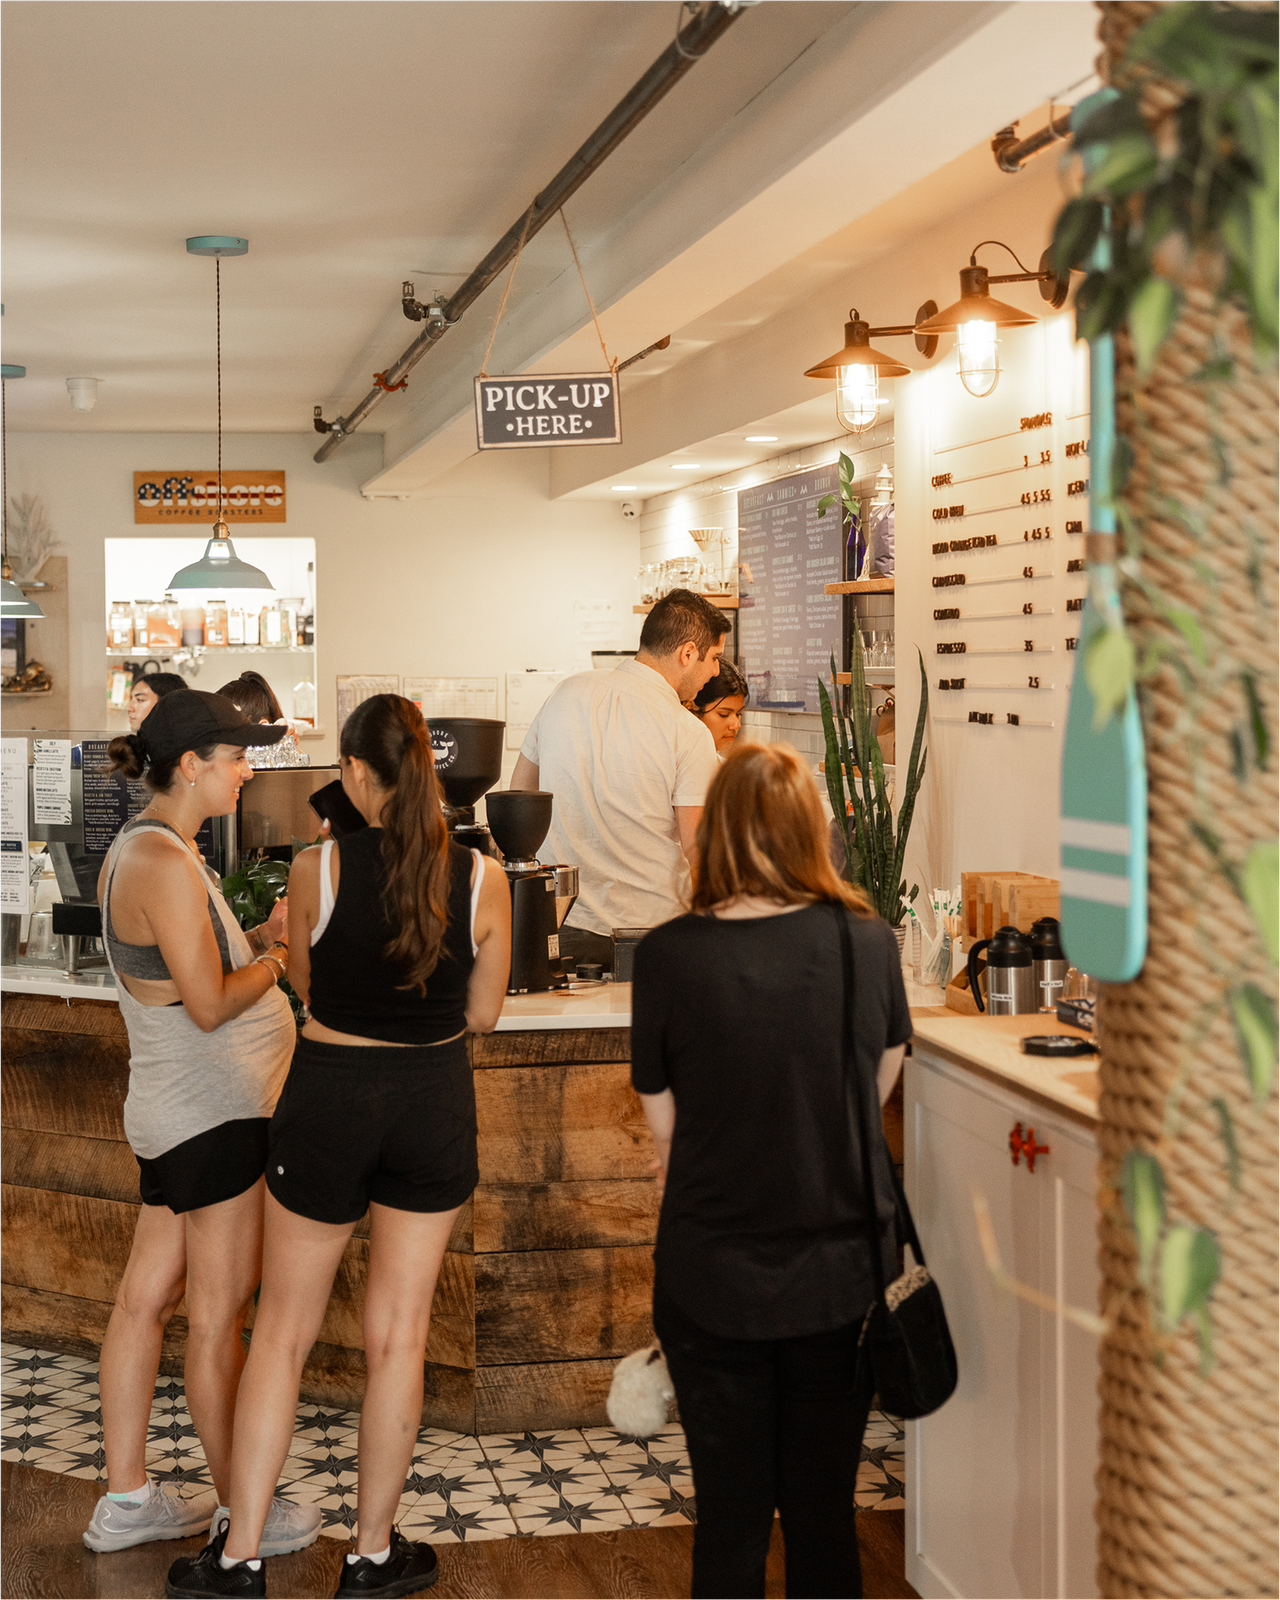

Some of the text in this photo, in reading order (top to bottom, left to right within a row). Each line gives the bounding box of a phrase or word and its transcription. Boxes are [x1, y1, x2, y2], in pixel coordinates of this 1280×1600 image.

[485, 383, 610, 411] PICK-UP
[515, 414, 583, 436] HERE
[814, 476, 831, 491] BRUNCH
[931, 472, 951, 488] COFFEE
[137, 476, 284, 507] offshore
[207, 508, 264, 516] ROASTERS
[932, 507, 949, 519] COLD
[985, 534, 998, 547] TEA
[936, 642, 967, 655] ESPRESSO
